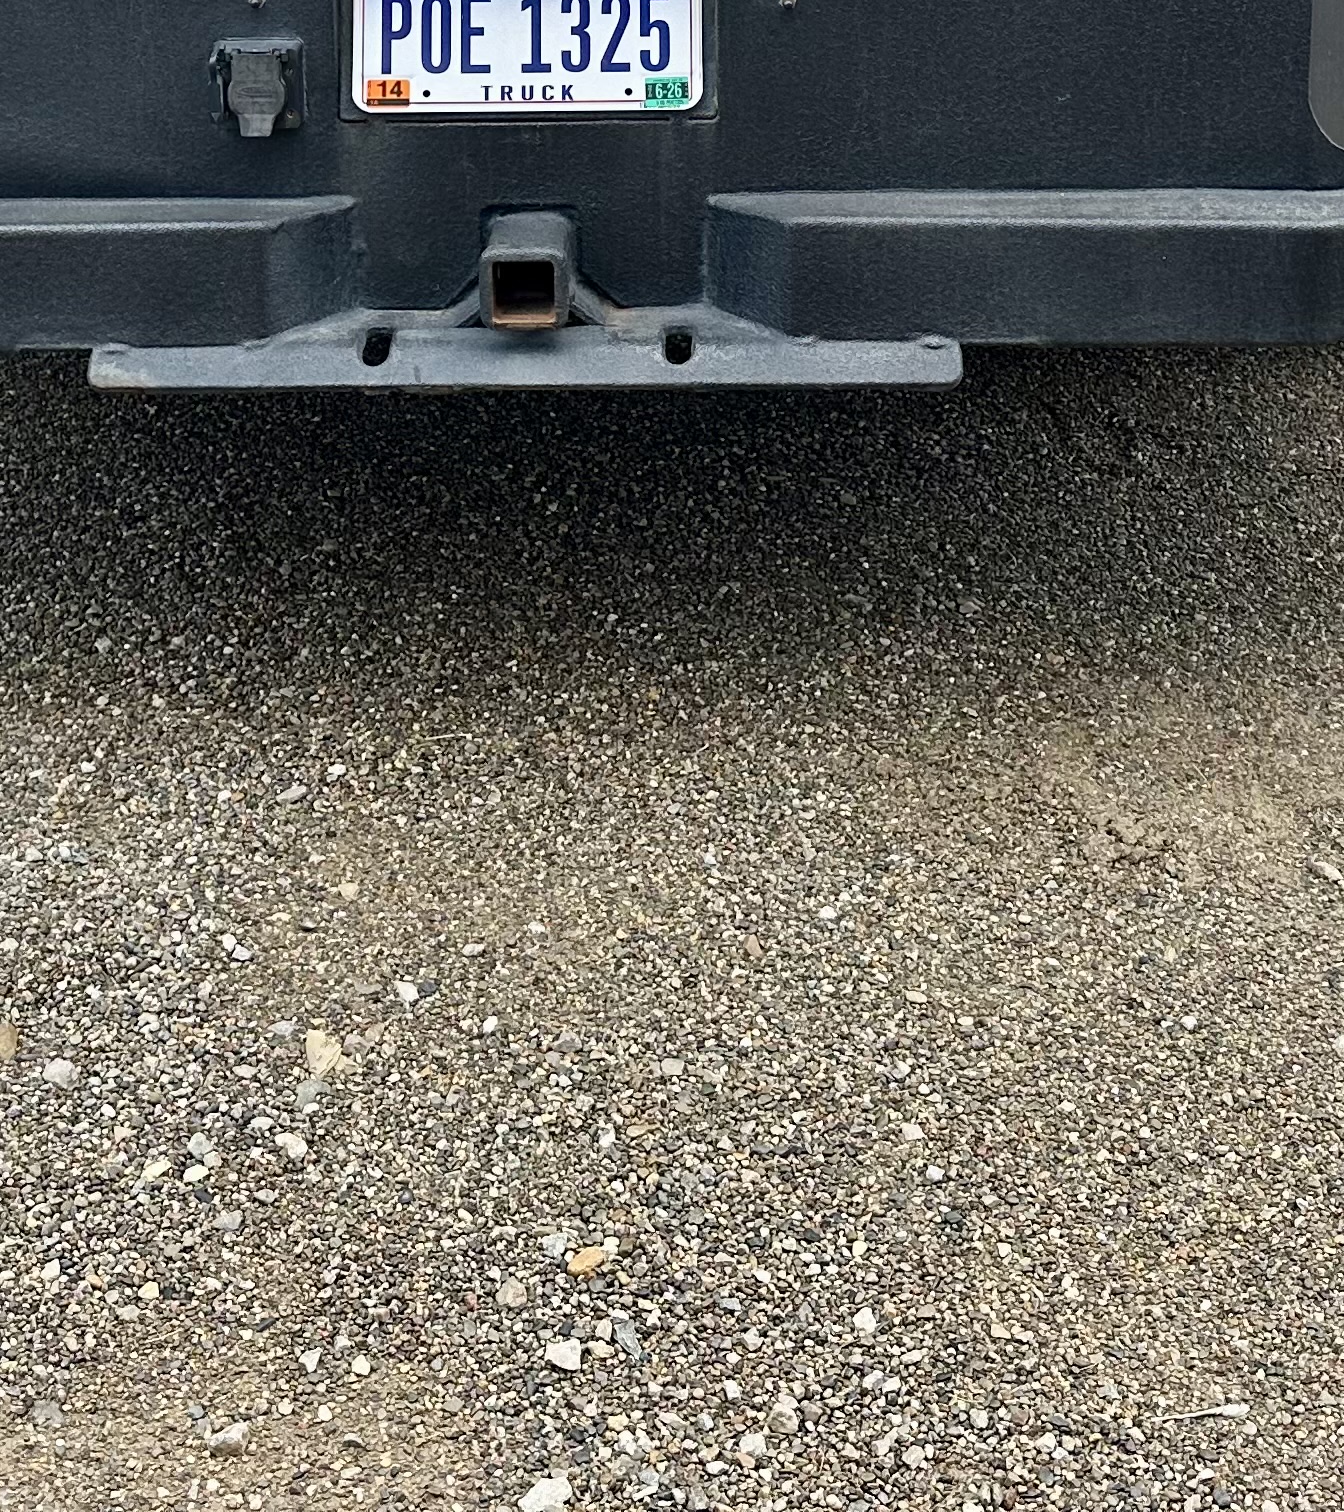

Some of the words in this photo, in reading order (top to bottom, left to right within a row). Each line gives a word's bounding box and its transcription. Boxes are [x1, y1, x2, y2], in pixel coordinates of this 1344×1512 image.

[376, 80, 403, 98] 14
[481, 84, 575, 102] TRUCK
[655, 82, 683, 99] 6-26
